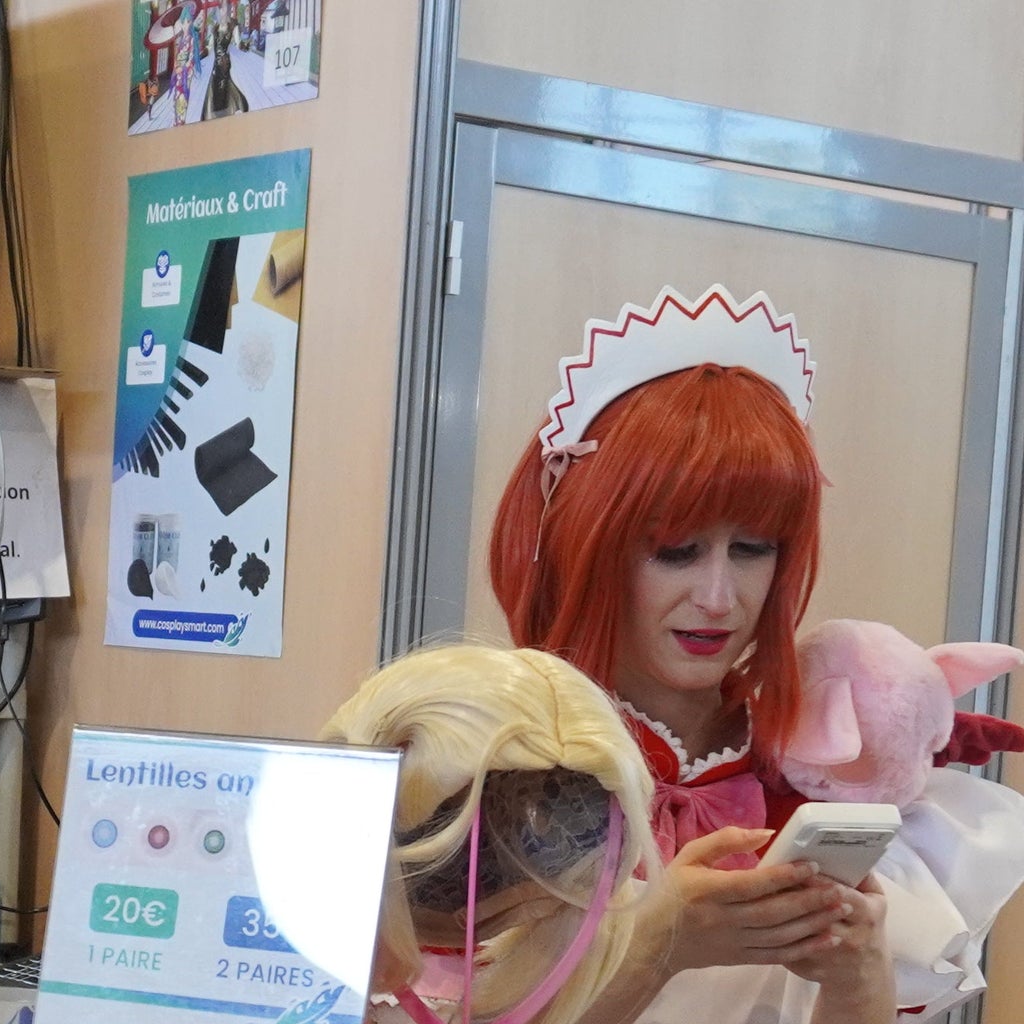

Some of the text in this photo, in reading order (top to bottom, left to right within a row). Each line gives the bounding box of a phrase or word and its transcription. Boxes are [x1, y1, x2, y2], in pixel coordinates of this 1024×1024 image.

[275, 45, 300, 70] 107
[146, 180, 288, 224] Matériaux & Craft
[138, 618, 224, 634] www.cosplaysmart.com
[86, 759, 255, 796] Lentilles an
[103, 895, 166, 926] 20€
[242, 909, 278, 938] 35
[88, 945, 163, 971] 1 PAIRE
[216, 959, 314, 987] 2 PAIRES
